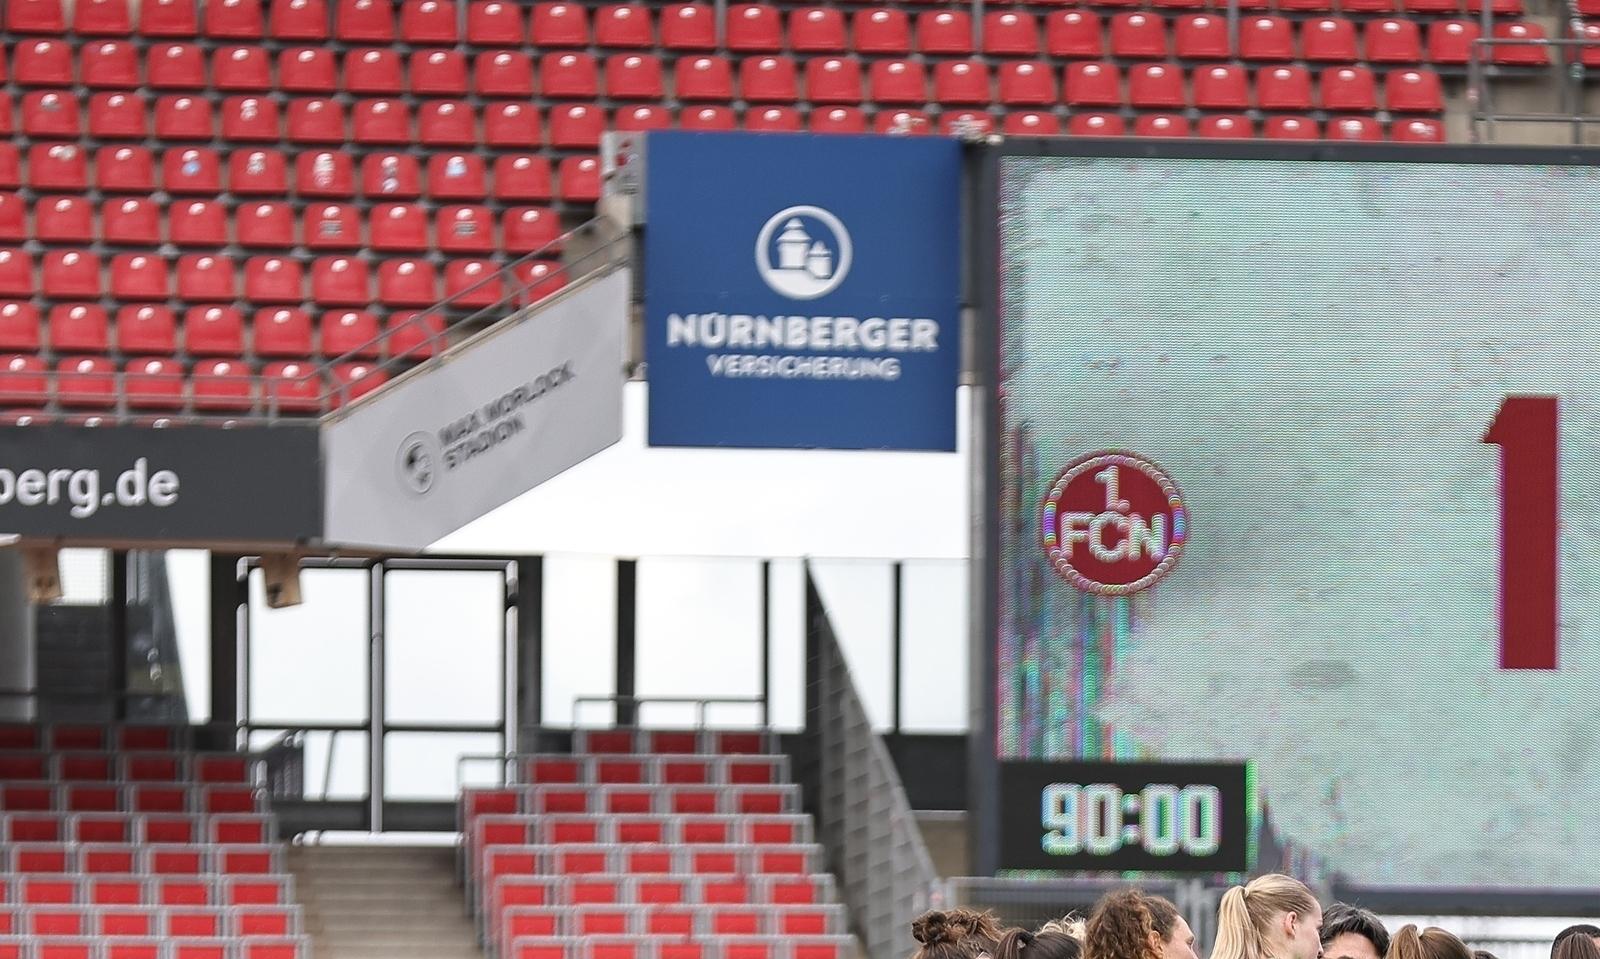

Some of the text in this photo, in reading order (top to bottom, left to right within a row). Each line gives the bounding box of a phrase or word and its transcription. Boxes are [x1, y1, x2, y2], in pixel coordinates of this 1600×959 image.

[667, 313, 939, 351] NÜRNBERGER
[706, 354, 901, 380] VERSICHERUNG
[438, 359, 576, 446] MAX MORLOCK
[442, 412, 526, 471] STADION
[1095, 465, 1130, 512] 1.
[1060, 511, 1168, 563] FCN
[1041, 783, 1222, 856] 90:00
